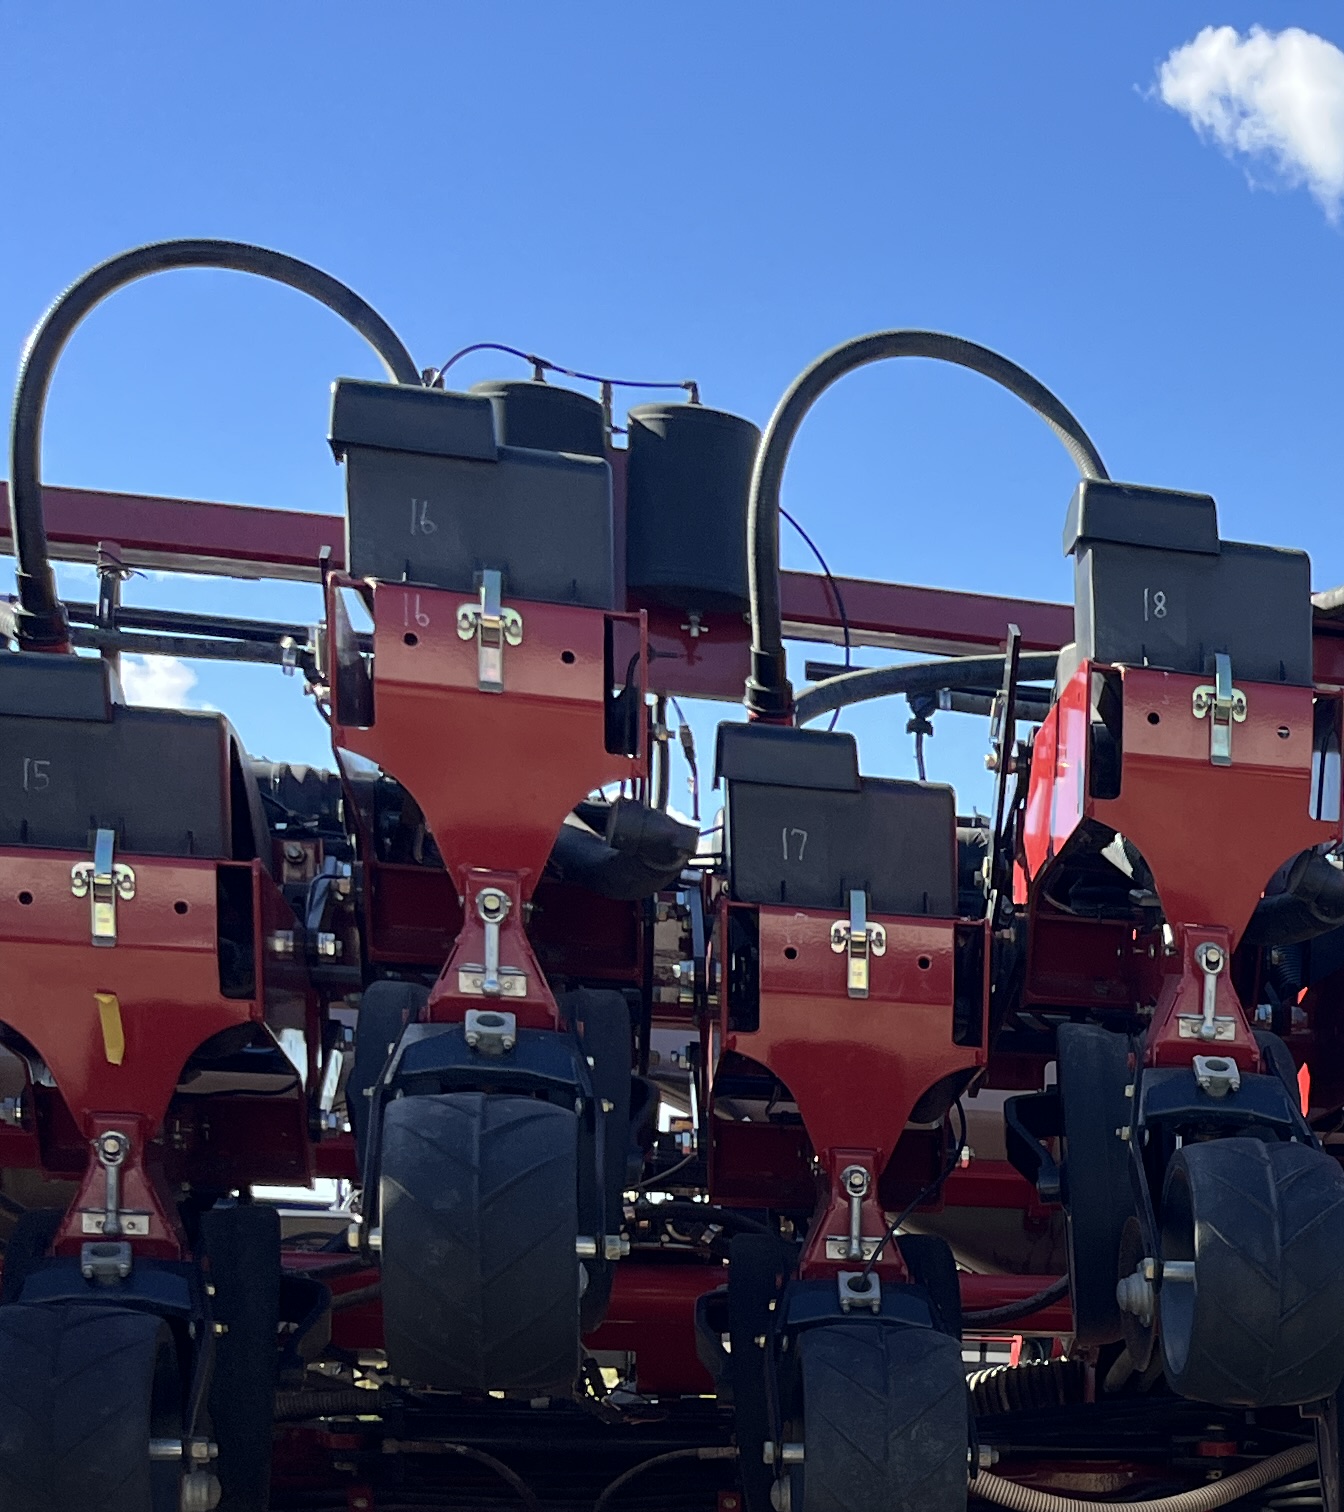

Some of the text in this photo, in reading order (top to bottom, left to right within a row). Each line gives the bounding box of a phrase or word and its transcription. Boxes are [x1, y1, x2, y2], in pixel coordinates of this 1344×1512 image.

[411, 497, 438, 536] 16
[404, 592, 430, 628] 16
[1144, 587, 1168, 622] 18
[23, 757, 51, 791] 15
[782, 826, 808, 861] 17
